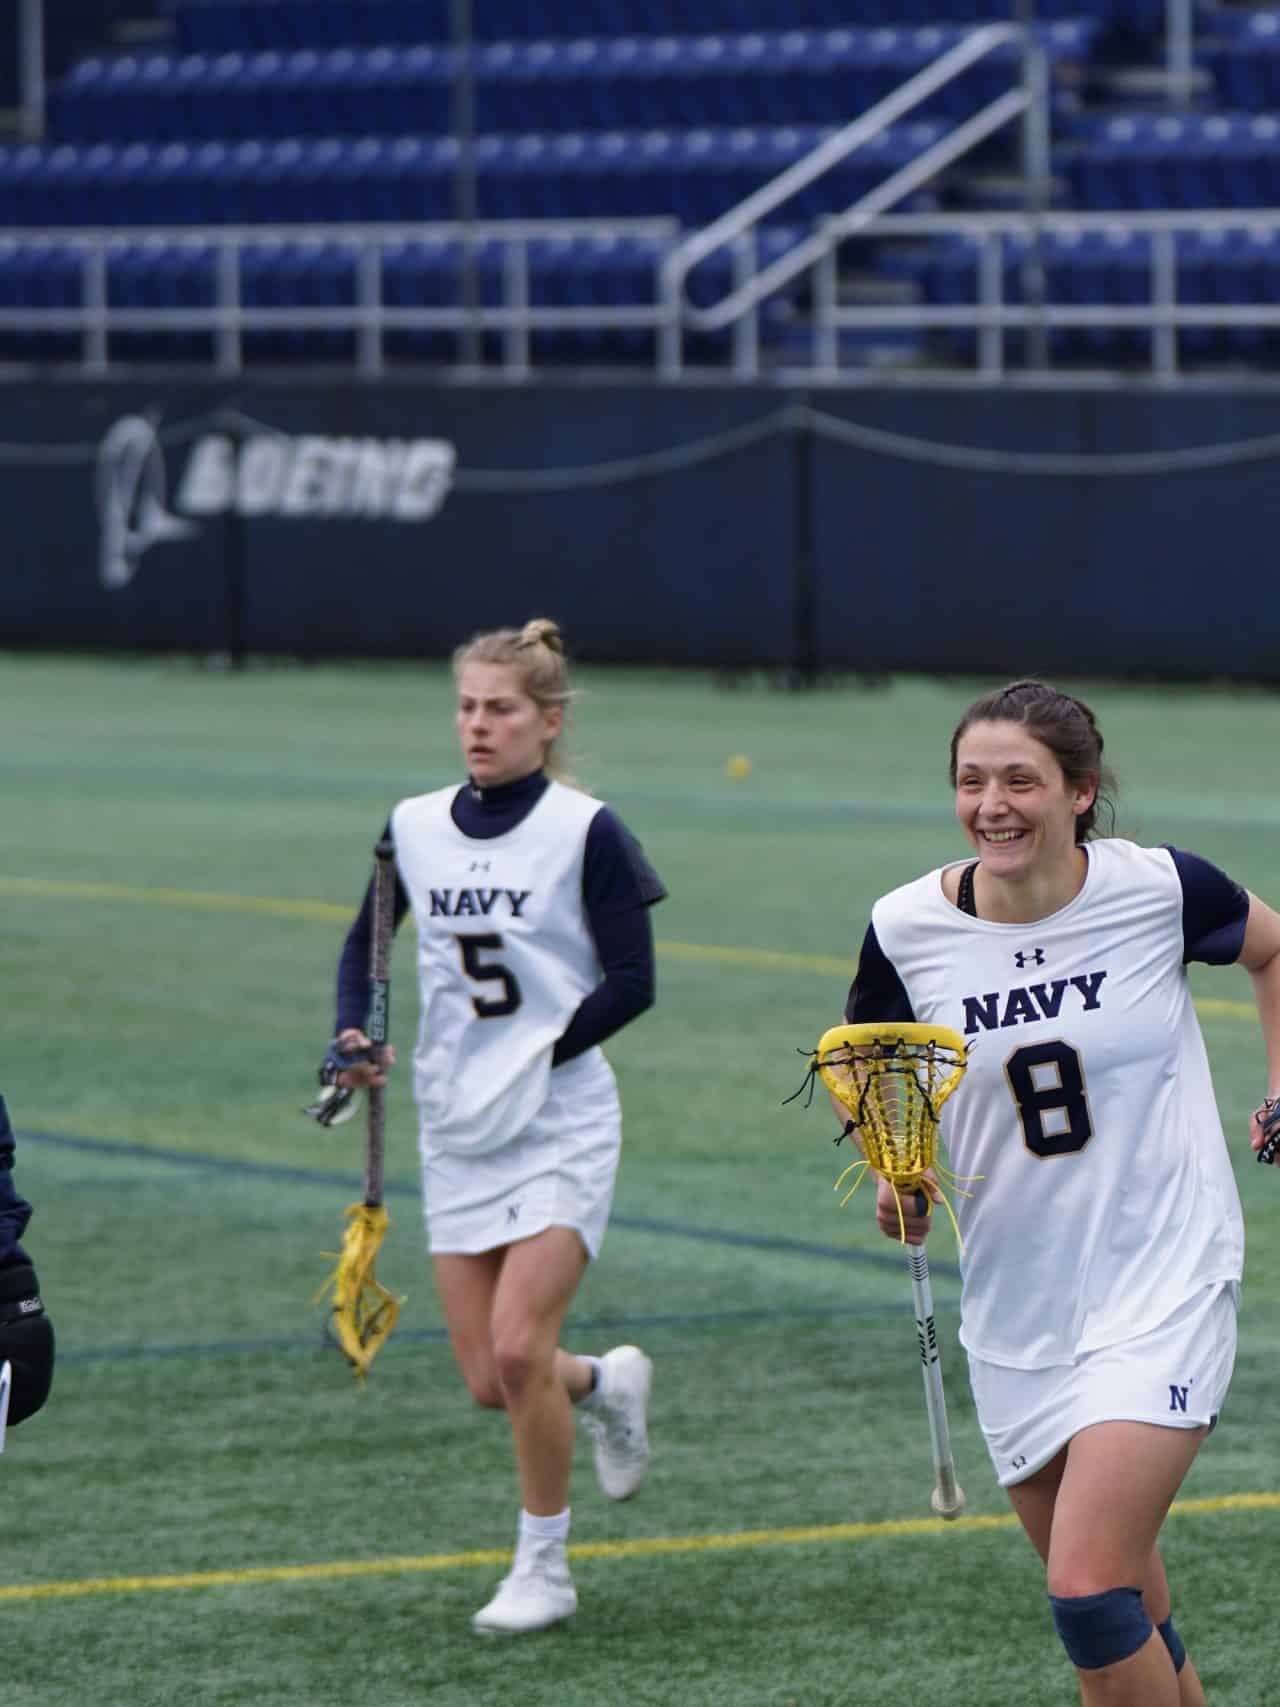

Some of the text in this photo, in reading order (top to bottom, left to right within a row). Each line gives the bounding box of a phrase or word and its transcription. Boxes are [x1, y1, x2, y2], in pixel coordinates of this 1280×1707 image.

[430, 888, 533, 918] NAVY
[453, 933, 522, 1019] 5
[962, 970, 1108, 1035] NAVY
[1003, 1039, 1096, 1160] 8
[1169, 1384, 1189, 1413] N
